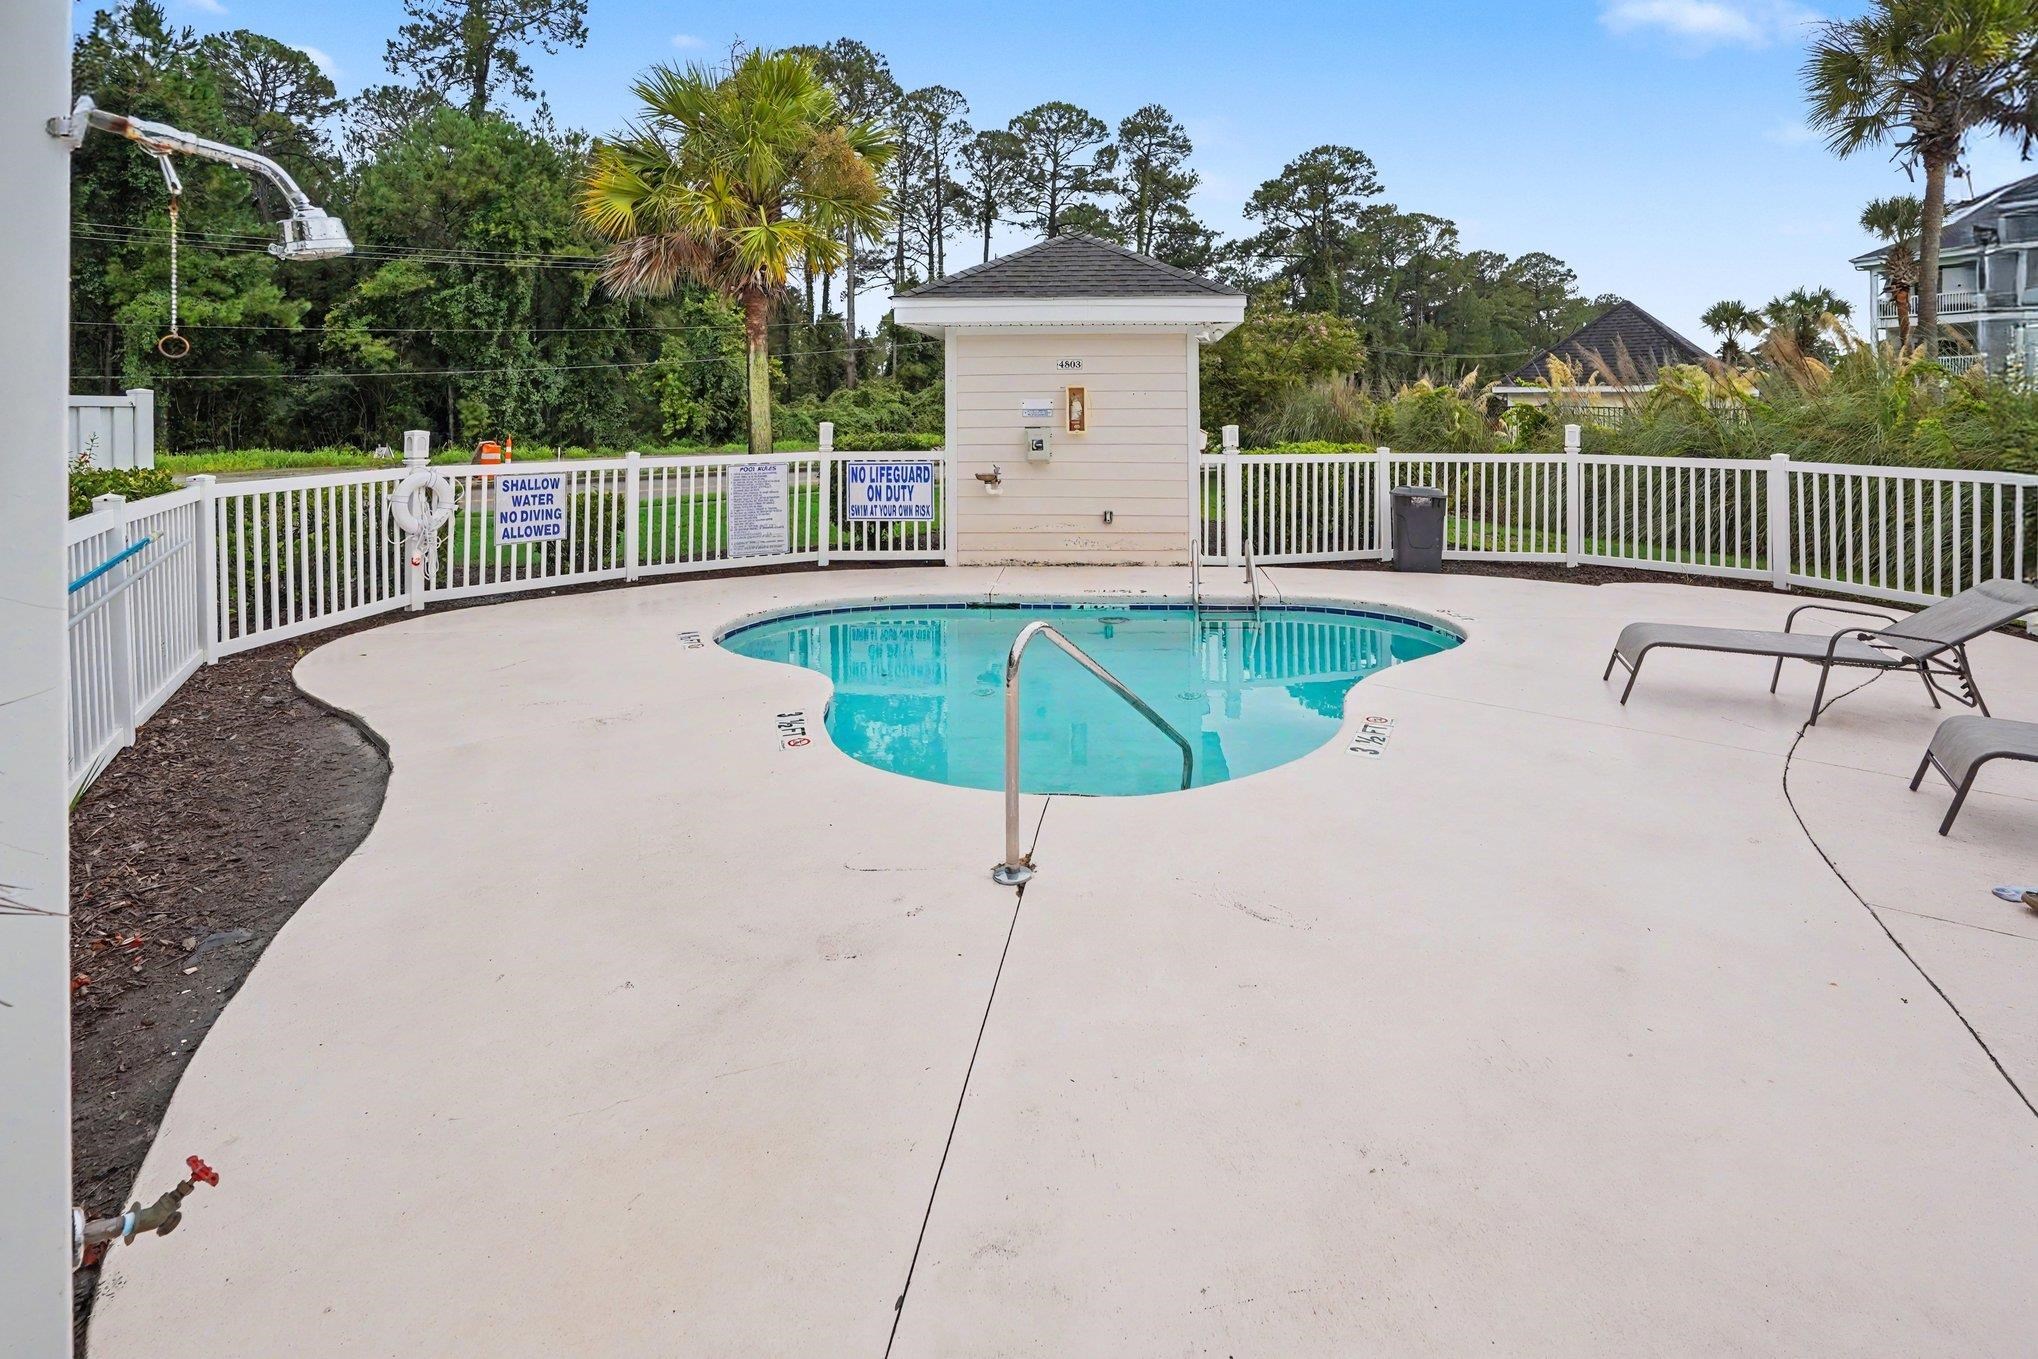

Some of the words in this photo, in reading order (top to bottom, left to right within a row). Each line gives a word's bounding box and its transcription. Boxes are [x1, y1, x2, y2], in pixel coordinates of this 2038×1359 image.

[1059, 360, 1081, 369] 4803
[851, 466, 866, 483] NO
[869, 466, 930, 483] LIFEGUARD
[502, 477, 560, 492] SHALLOW
[512, 493, 554, 507] WATER
[867, 484, 882, 502] ON
[886, 484, 914, 502] DUTY
[500, 511, 518, 524] NO
[520, 508, 562, 522] DIVING
[851, 504, 868, 517] SWIM
[870, 504, 878, 517] AT
[879, 504, 897, 517] YOUR
[898, 504, 913, 517] OWN
[915, 504, 931, 517] RISK
[502, 523, 561, 540] ALLOWED
